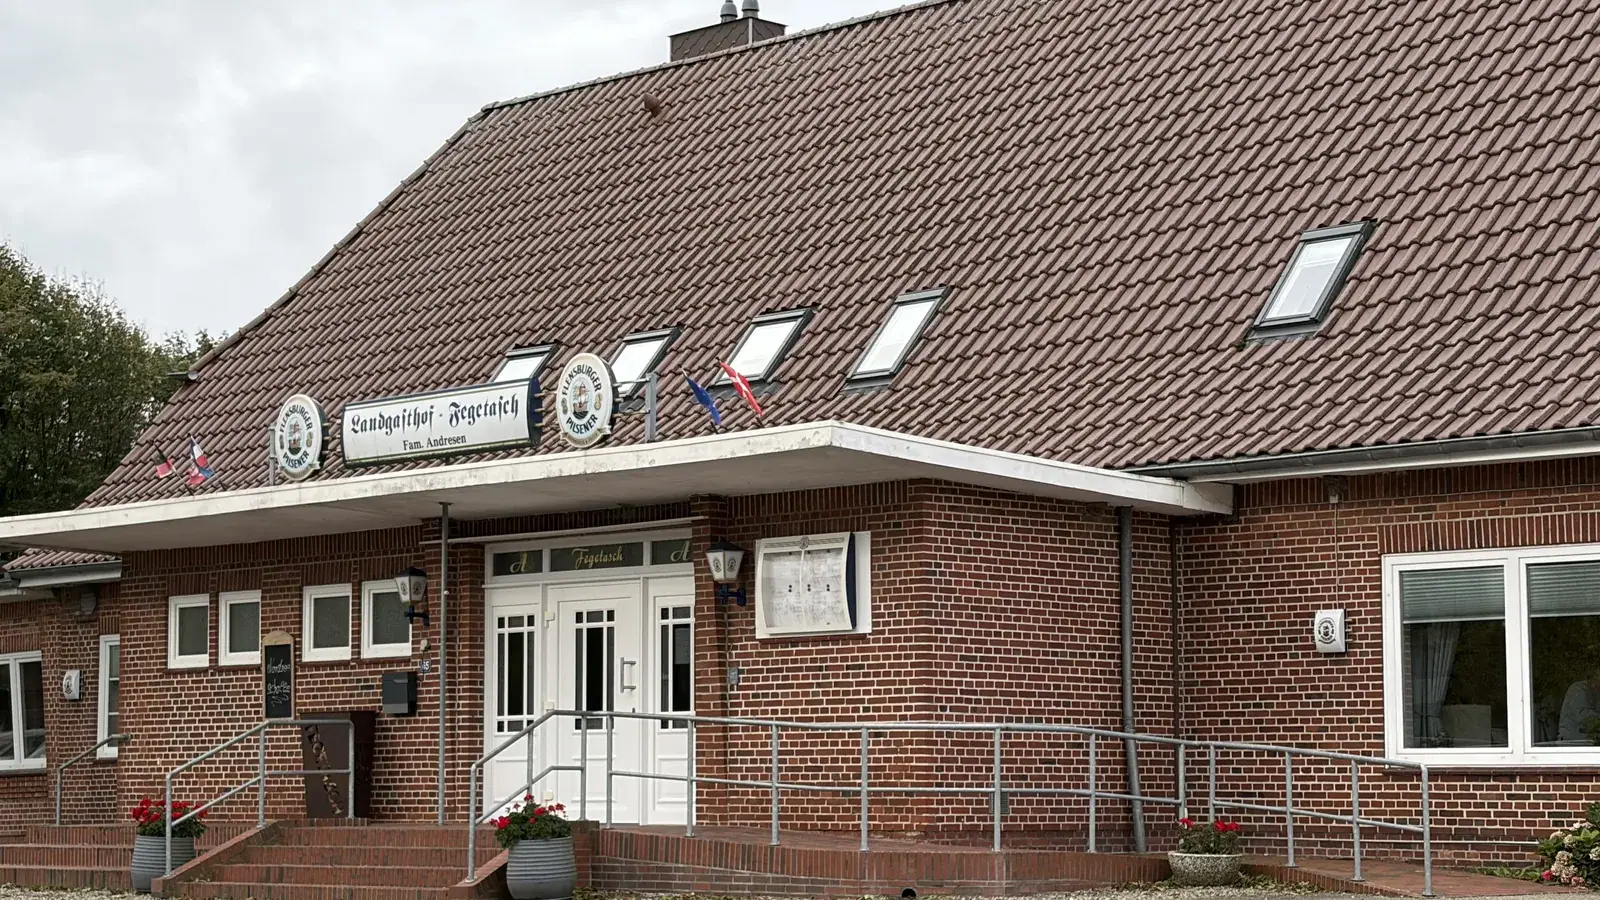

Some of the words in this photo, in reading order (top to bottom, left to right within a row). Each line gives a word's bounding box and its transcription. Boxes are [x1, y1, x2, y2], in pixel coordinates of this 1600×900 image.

[561, 364, 602, 395] FLENSBURGER
[279, 404, 313, 433] FLENSBURGER
[351, 405, 434, 436] Landgasthof
[449, 393, 519, 428] Fegetasch
[566, 414, 598, 434] PILSENER
[402, 439, 424, 451] Fam.
[426, 433, 467, 448] Andresen
[283, 451, 309, 468] PILSENER
[571, 545, 624, 570] Fegetasch
